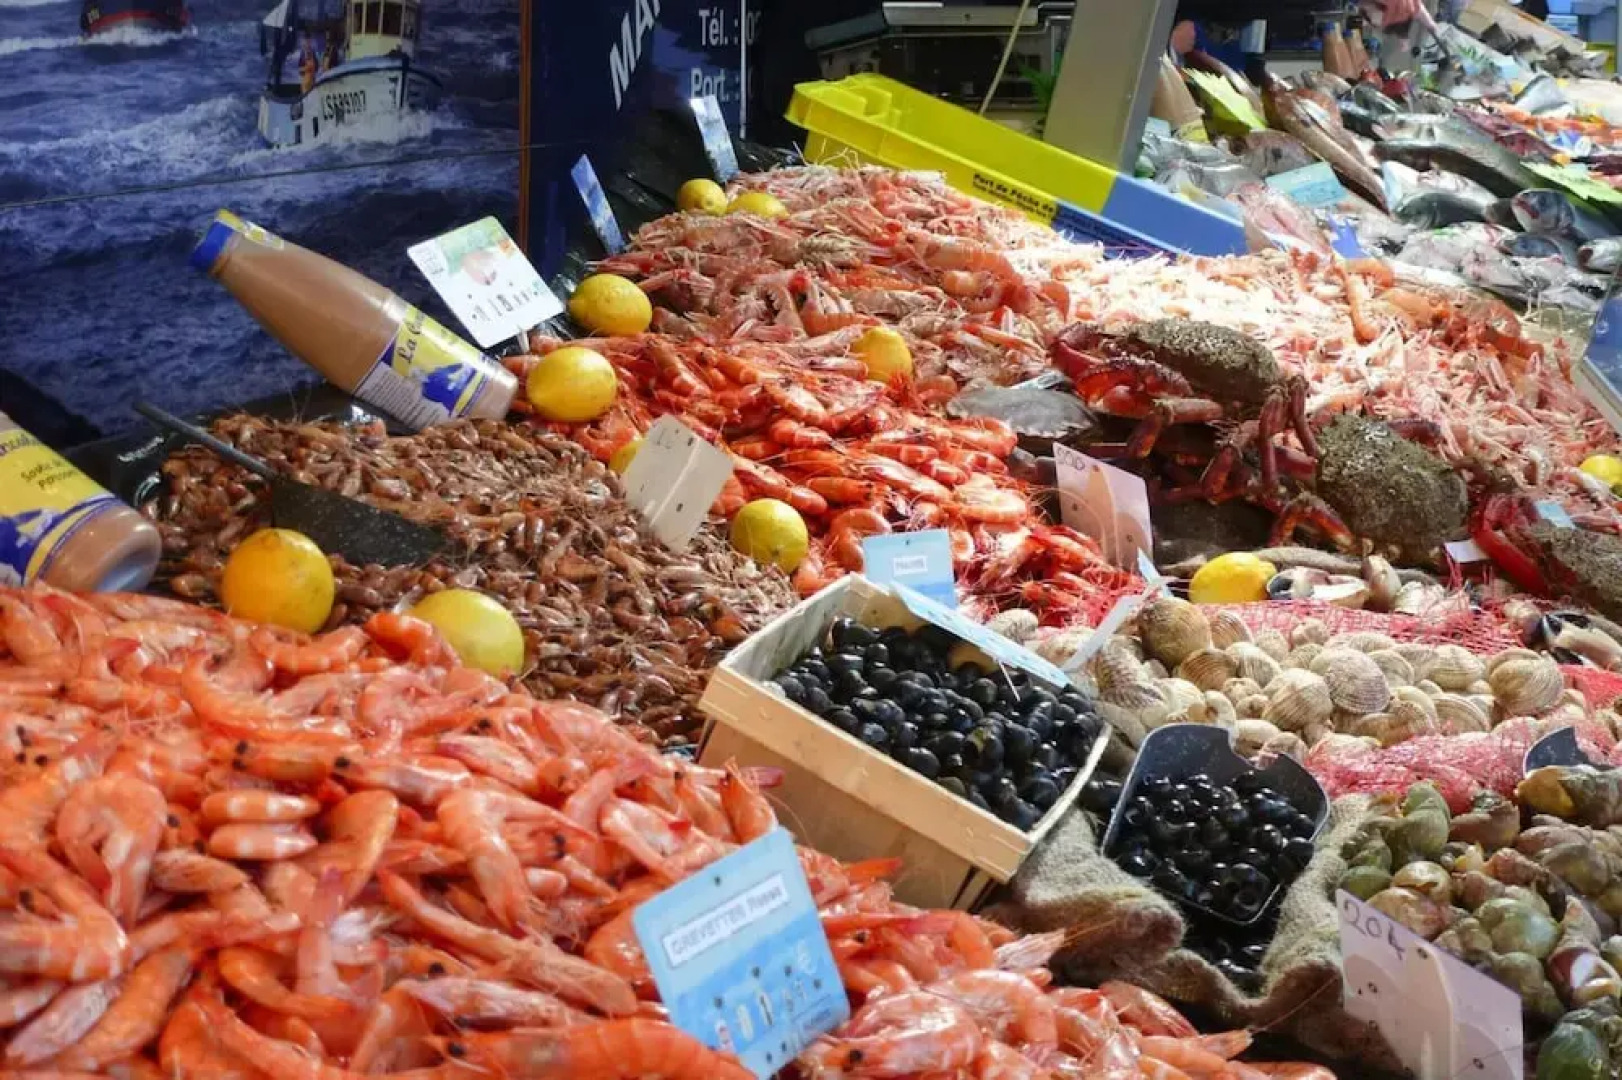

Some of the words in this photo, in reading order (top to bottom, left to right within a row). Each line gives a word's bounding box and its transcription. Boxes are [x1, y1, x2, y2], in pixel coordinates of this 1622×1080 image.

[698, 7, 729, 47] Tél.
[609, 0, 661, 112] MA
[690, 66, 730, 102] Port.
